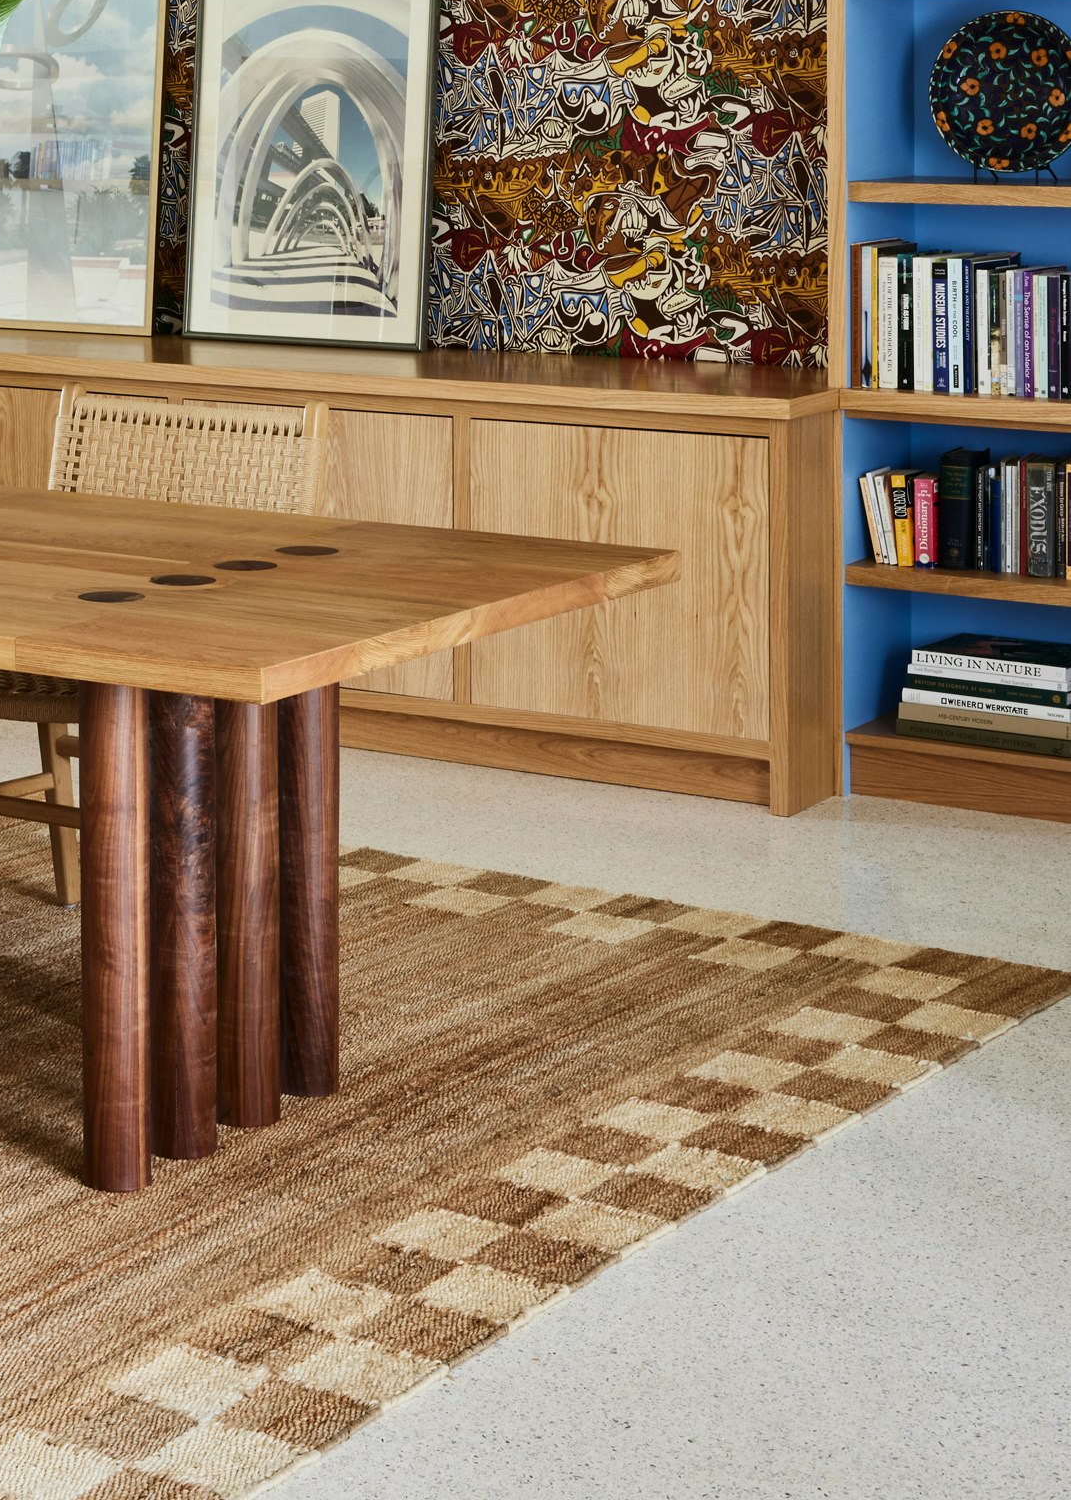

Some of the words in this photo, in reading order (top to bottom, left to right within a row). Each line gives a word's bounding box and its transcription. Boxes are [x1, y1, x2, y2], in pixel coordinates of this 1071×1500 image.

[935, 283, 945, 315] MUSEUM
[936, 317, 946, 348] STUDIES
[892, 490, 907, 517] OXFORD
[919, 500, 929, 550] Dictionary
[1030, 486, 1048, 554] EXODUS
[917, 653, 963, 667] LIVING
[967, 659, 981, 669] IN
[986, 661, 1041, 677] NATURE
[938, 682, 969, 691] DESIGNERS
[948, 698, 977, 708] WIENER
[939, 713, 971, 723] MID-CENTURY
[910, 726, 943, 735] PORTRAITS
[958, 731, 976, 741] HOME
[1002, 738, 1036, 749] INTERIORS
